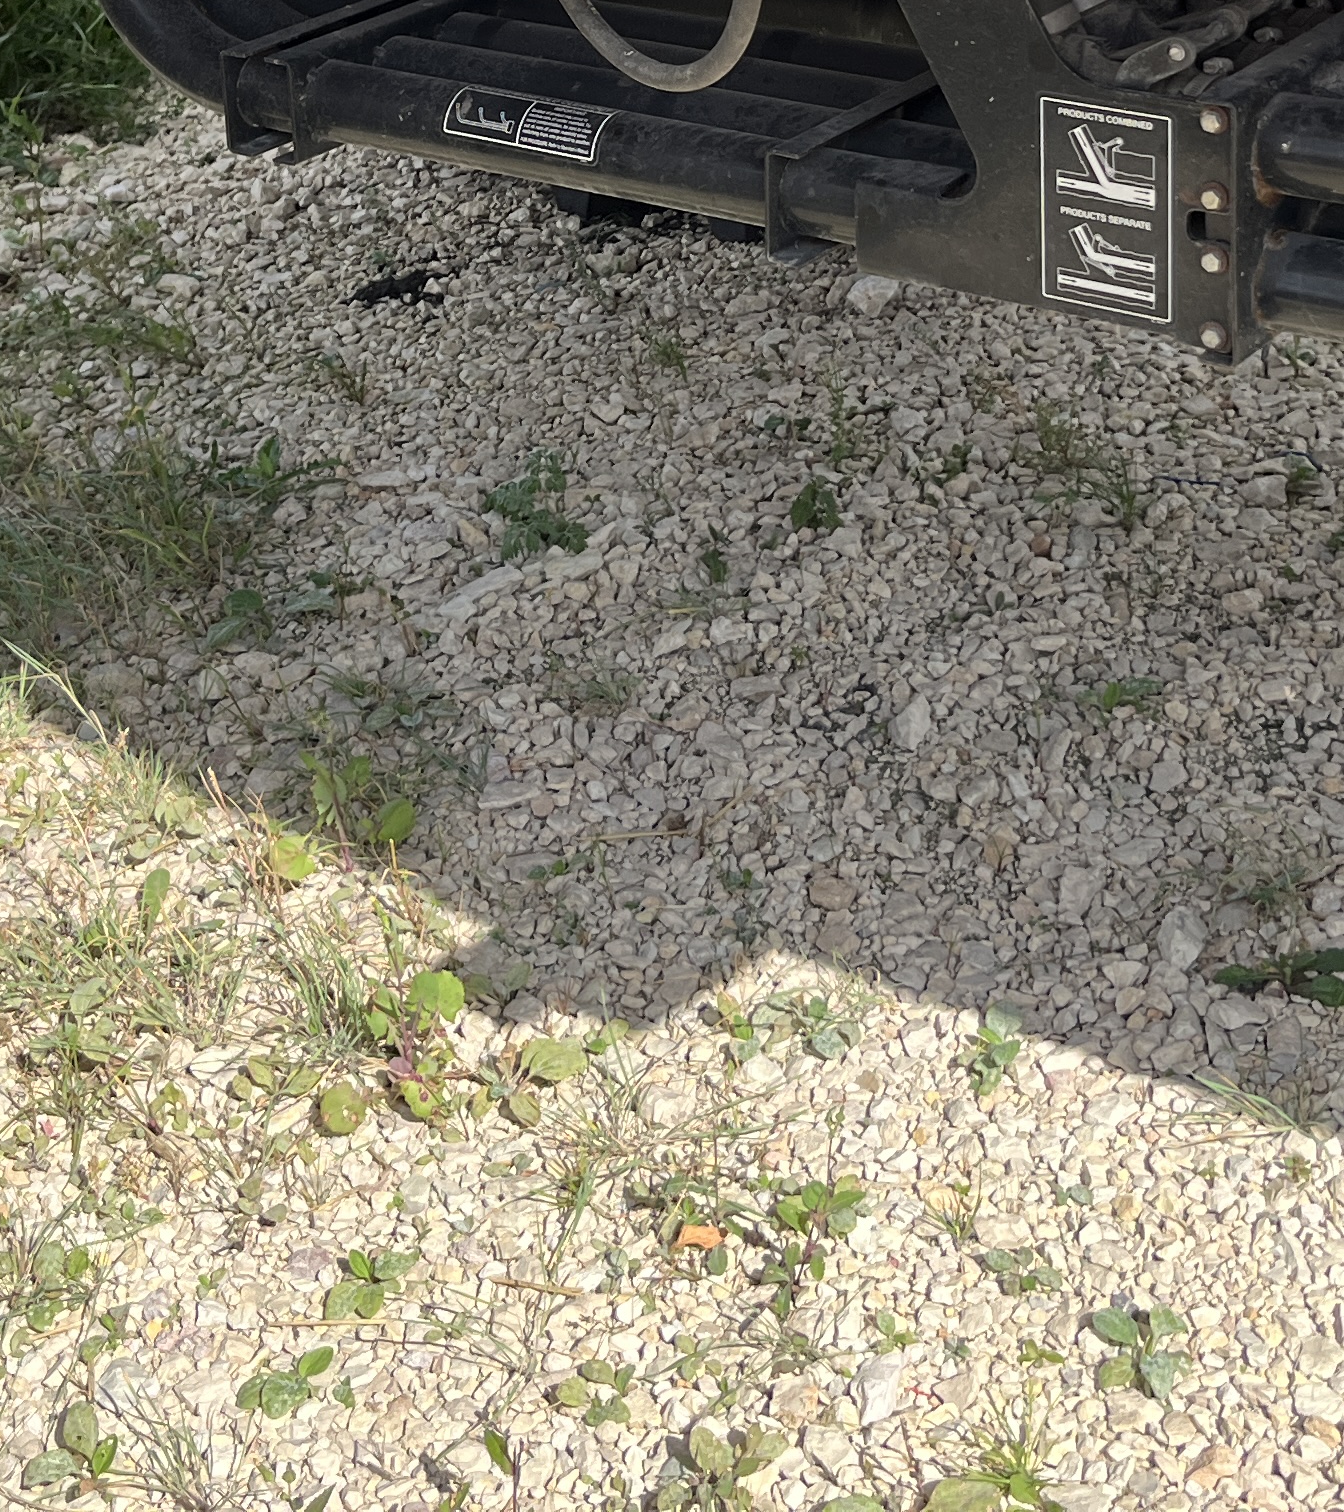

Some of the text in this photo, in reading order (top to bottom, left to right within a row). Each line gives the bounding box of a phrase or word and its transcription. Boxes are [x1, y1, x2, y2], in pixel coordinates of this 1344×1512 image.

[1058, 107, 1153, 131] PRODUCTS COMBINED
[1060, 206, 1152, 231] PRODUCTS SEPARATE
